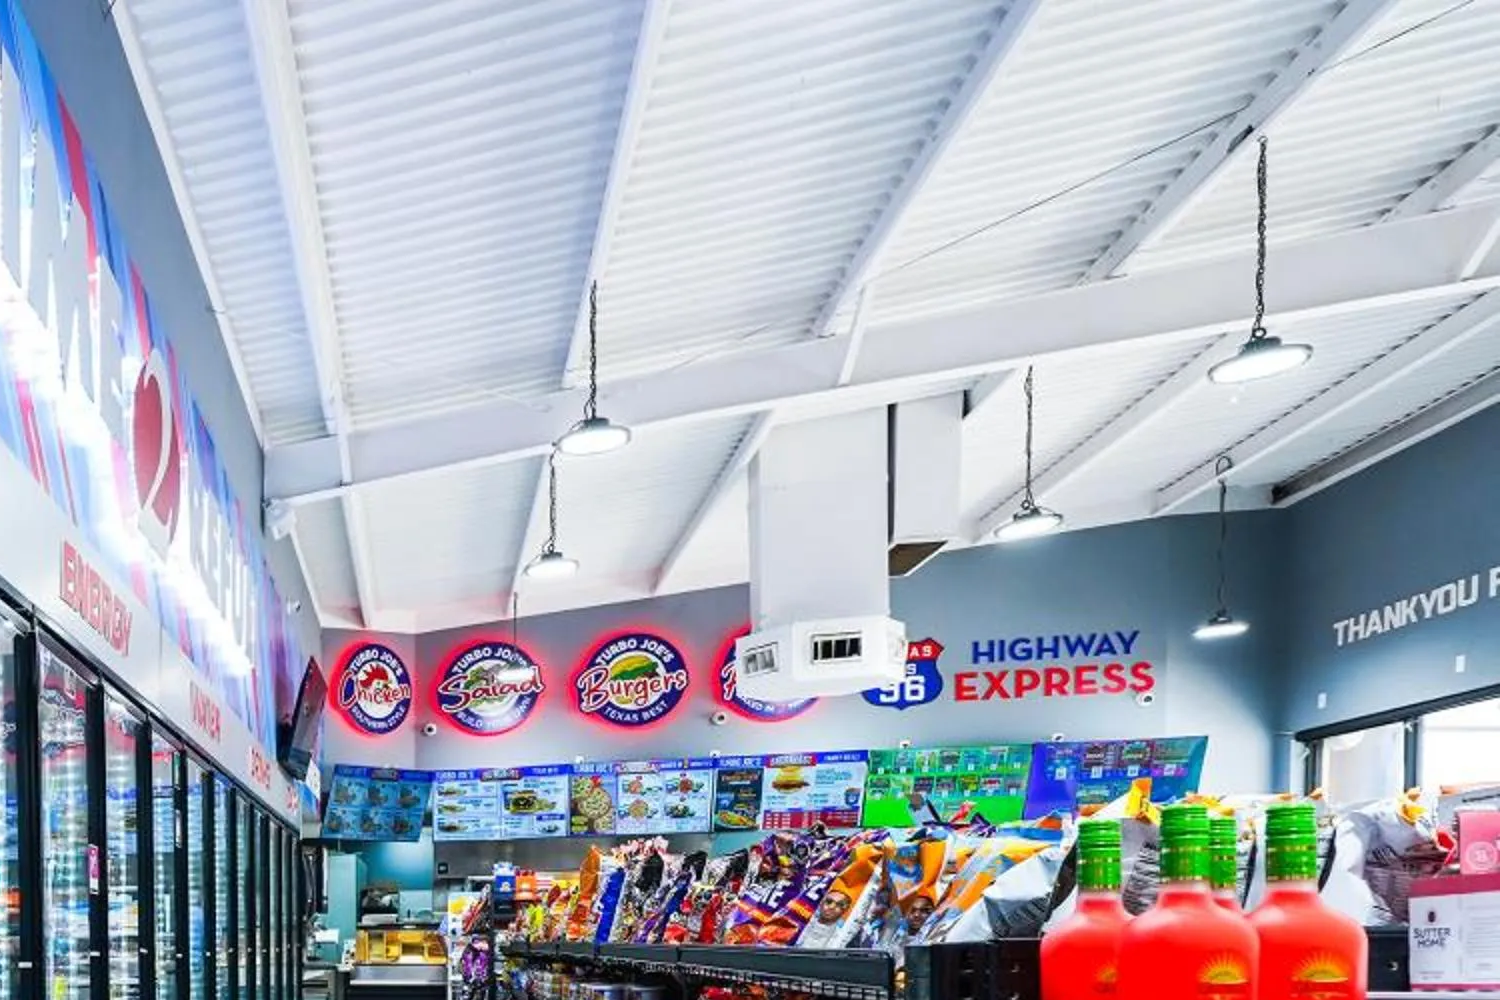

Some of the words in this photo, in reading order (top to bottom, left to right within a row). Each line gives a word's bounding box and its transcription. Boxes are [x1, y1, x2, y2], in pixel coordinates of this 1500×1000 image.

[60, 540, 132, 657] ENERGY
[350, 650, 379, 673] TURBO
[451, 647, 492, 674] TURBO
[595, 638, 638, 667] TURBO
[639, 639, 675, 664] JOE'S
[971, 630, 1140, 665] HIGHWAY
[338, 671, 412, 708] Chicken
[437, 665, 546, 713] Salad
[577, 666, 690, 713] Burgers
[954, 661, 1157, 702] EXPRESS
[604, 705, 640, 723] TEXAS
[640, 700, 669, 722] BEST
[1413, 927, 1451, 939] SUTTER
[1418, 937, 1445, 948] HOME
